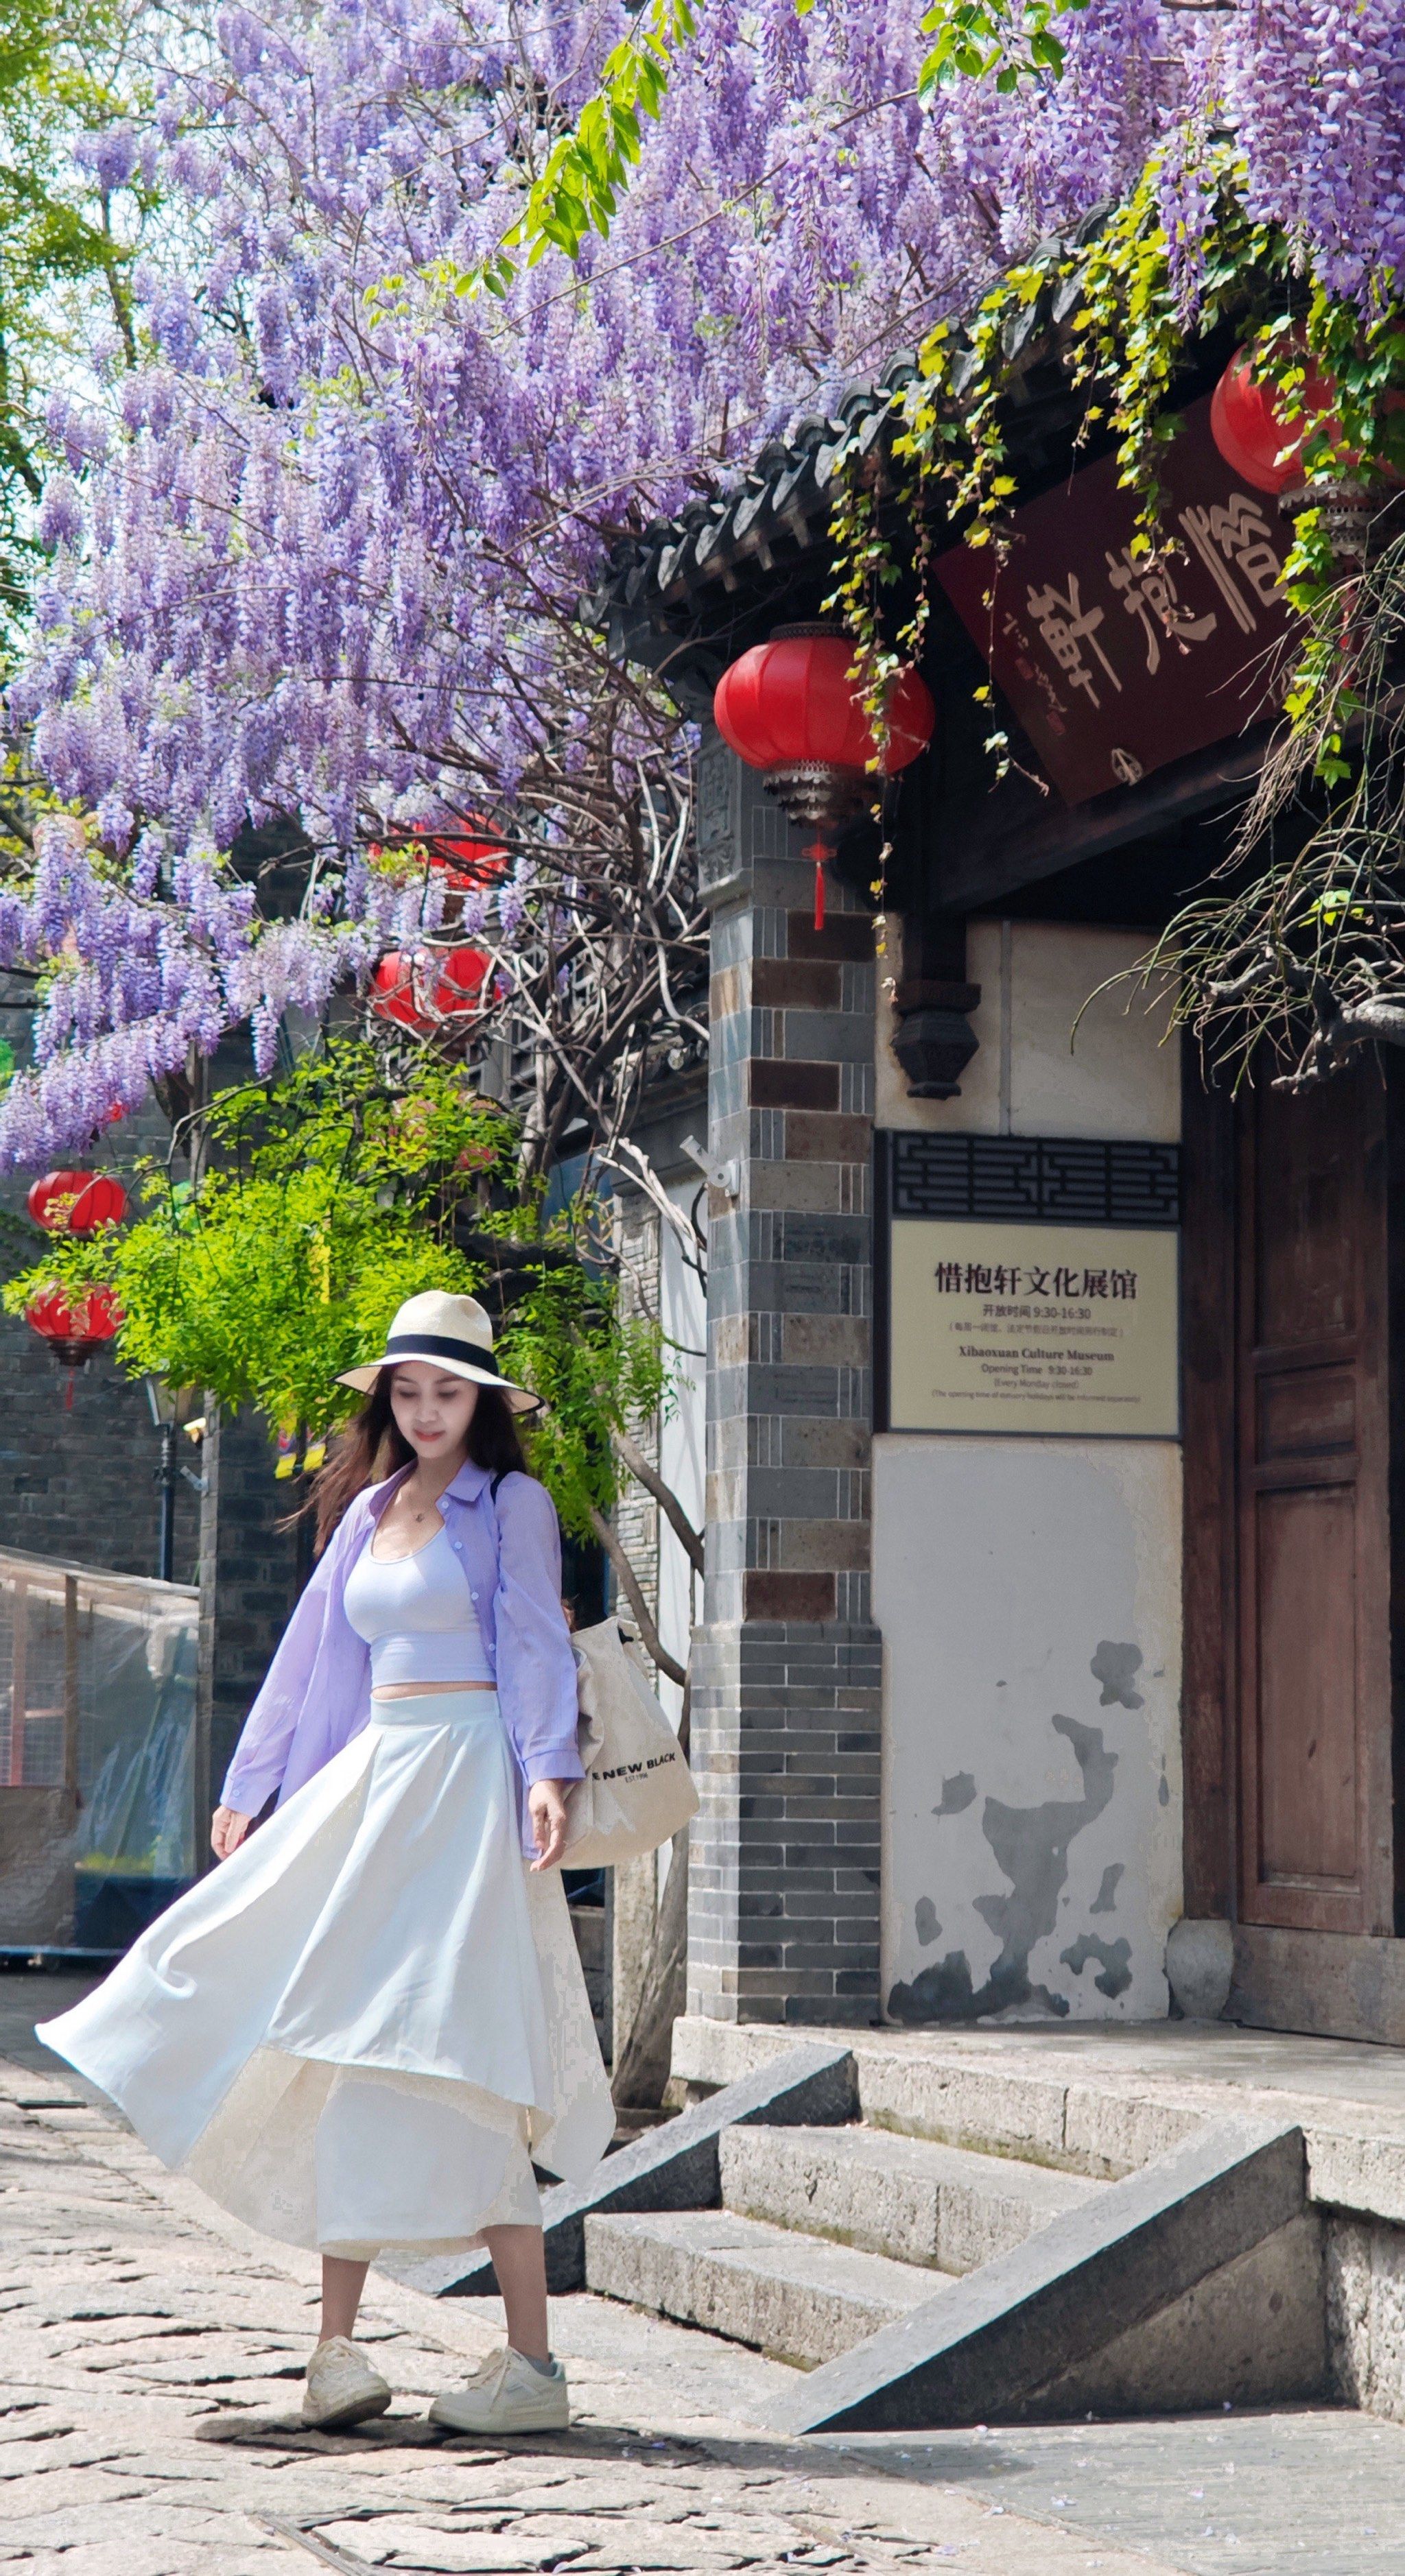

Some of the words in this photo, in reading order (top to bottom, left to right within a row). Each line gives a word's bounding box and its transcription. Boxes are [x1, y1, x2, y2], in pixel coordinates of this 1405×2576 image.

[934, 1261, 1138, 1300] 惜抱轩文化展馆
[982, 1304, 1031, 1318] 开放时间
[1033, 1306, 1091, 1320] 9:30-16:30
[959, 1346, 1019, 1358] Xibaoxuan
[1022, 1348, 1065, 1360] Culture
[1067, 1350, 1115, 1361] Museum
[982, 1363, 1019, 1376] Opening
[1020, 1364, 1043, 1374] Time
[602, 1762, 643, 1780] NEW
[646, 1752, 676, 1769] BLACK
